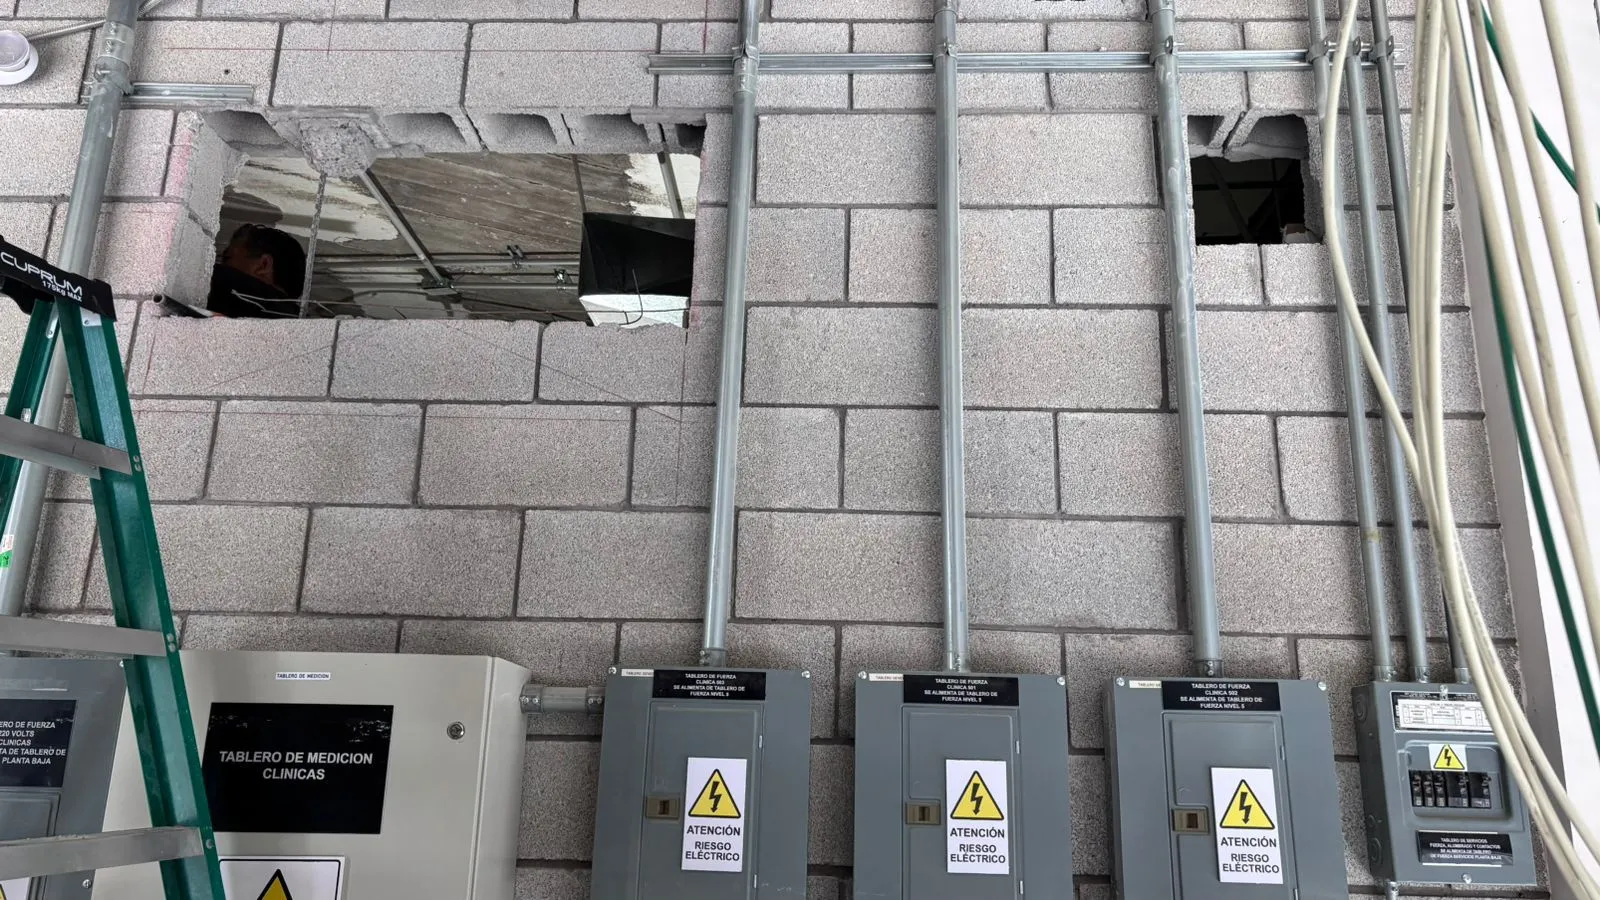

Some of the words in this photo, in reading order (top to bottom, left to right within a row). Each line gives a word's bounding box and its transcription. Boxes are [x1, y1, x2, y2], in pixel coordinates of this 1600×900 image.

[0, 251, 82, 296] CUPRUM
[42, 280, 66, 297] 175kg
[67, 291, 82, 302] MAX
[27, 721, 56, 729] FUERZA
[20, 748, 55, 756] TABLERO
[220, 751, 282, 763] TABLERO
[285, 752, 304, 763] DE
[307, 752, 373, 764] MEDICION
[31, 757, 52, 765] BAJA
[262, 768, 325, 780] CLINICAS
[686, 825, 740, 836] ATENCIÓN
[949, 827, 1005, 838] ATENCIÓN
[694, 841, 732, 851] RIESGO
[1220, 836, 1277, 847] ATENCIÓN
[959, 844, 997, 853] RIESGO
[685, 850, 740, 861] ELÉCTRICO
[950, 853, 1006, 863] ELÉCTRICO
[1231, 853, 1270, 863] RIESGO
[1222, 862, 1280, 873] ELÉCTRICO
